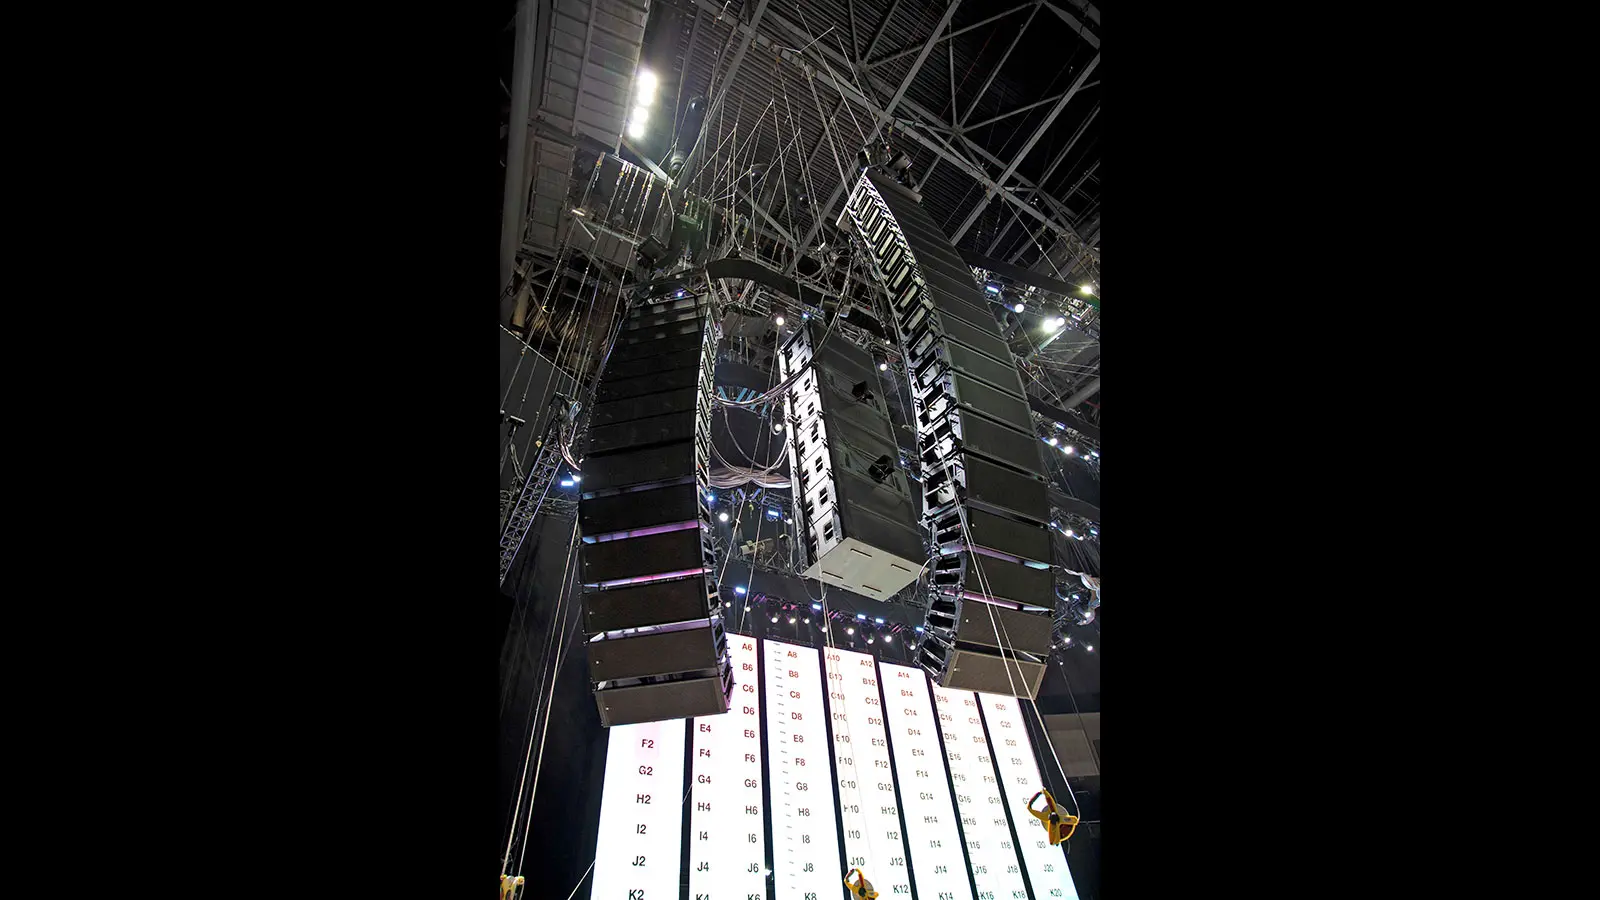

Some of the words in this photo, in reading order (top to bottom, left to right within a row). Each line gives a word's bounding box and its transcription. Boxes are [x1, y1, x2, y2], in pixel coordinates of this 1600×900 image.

[742, 643, 752, 651] A6
[742, 663, 753, 671] B6
[789, 670, 799, 678] B8
[863, 678, 875, 686] B12
[742, 684, 754, 693] C6
[790, 691, 800, 699] C8
[936, 695, 948, 703] B16
[865, 697, 879, 705] C12
[743, 706, 755, 715] D6
[792, 712, 802, 720] D8
[941, 714, 952, 722] C16
[868, 717, 882, 725] D12
[700, 724, 711, 733] E4
[744, 729, 755, 738] E6
[944, 733, 957, 741] D16
[793, 734, 804, 743] E8
[872, 738, 885, 747] E12
[642, 739, 654, 748] F2
[700, 749, 711, 758] F4
[745, 754, 755, 763] F6
[795, 758, 805, 766] F8
[875, 760, 888, 768] F12
[639, 765, 653, 776] G2
[698, 774, 711, 784] G4
[744, 779, 757, 788] G6
[796, 782, 808, 791] G8
[878, 783, 892, 791] G12
[636, 794, 651, 804] H2
[920, 792, 933, 800] G14
[958, 795, 971, 803] G16
[698, 802, 711, 812] H4
[746, 805, 758, 815] H6
[881, 807, 896, 815] H12
[798, 808, 810, 817] H8
[637, 824, 646, 834] I2
[700, 831, 708, 840] I4
[748, 833, 756, 843] I6
[848, 830, 860, 839] I10
[887, 832, 898, 840] I12
[802, 835, 810, 844] I8
[930, 840, 941, 848] I14
[970, 841, 980, 849] I16
[632, 856, 646, 866] J2
[850, 857, 865, 866] J10
[890, 857, 903, 866] J12
[697, 862, 709, 872] J4
[748, 863, 759, 874] J6
[803, 863, 814, 872] J8
[934, 866, 947, 874] J14
[975, 866, 987, 875] J16
[893, 884, 909, 894] K12
[629, 889, 644, 900] K2
[805, 892, 817, 900] K8
[939, 892, 953, 900] K14
[981, 891, 994, 900] K16
